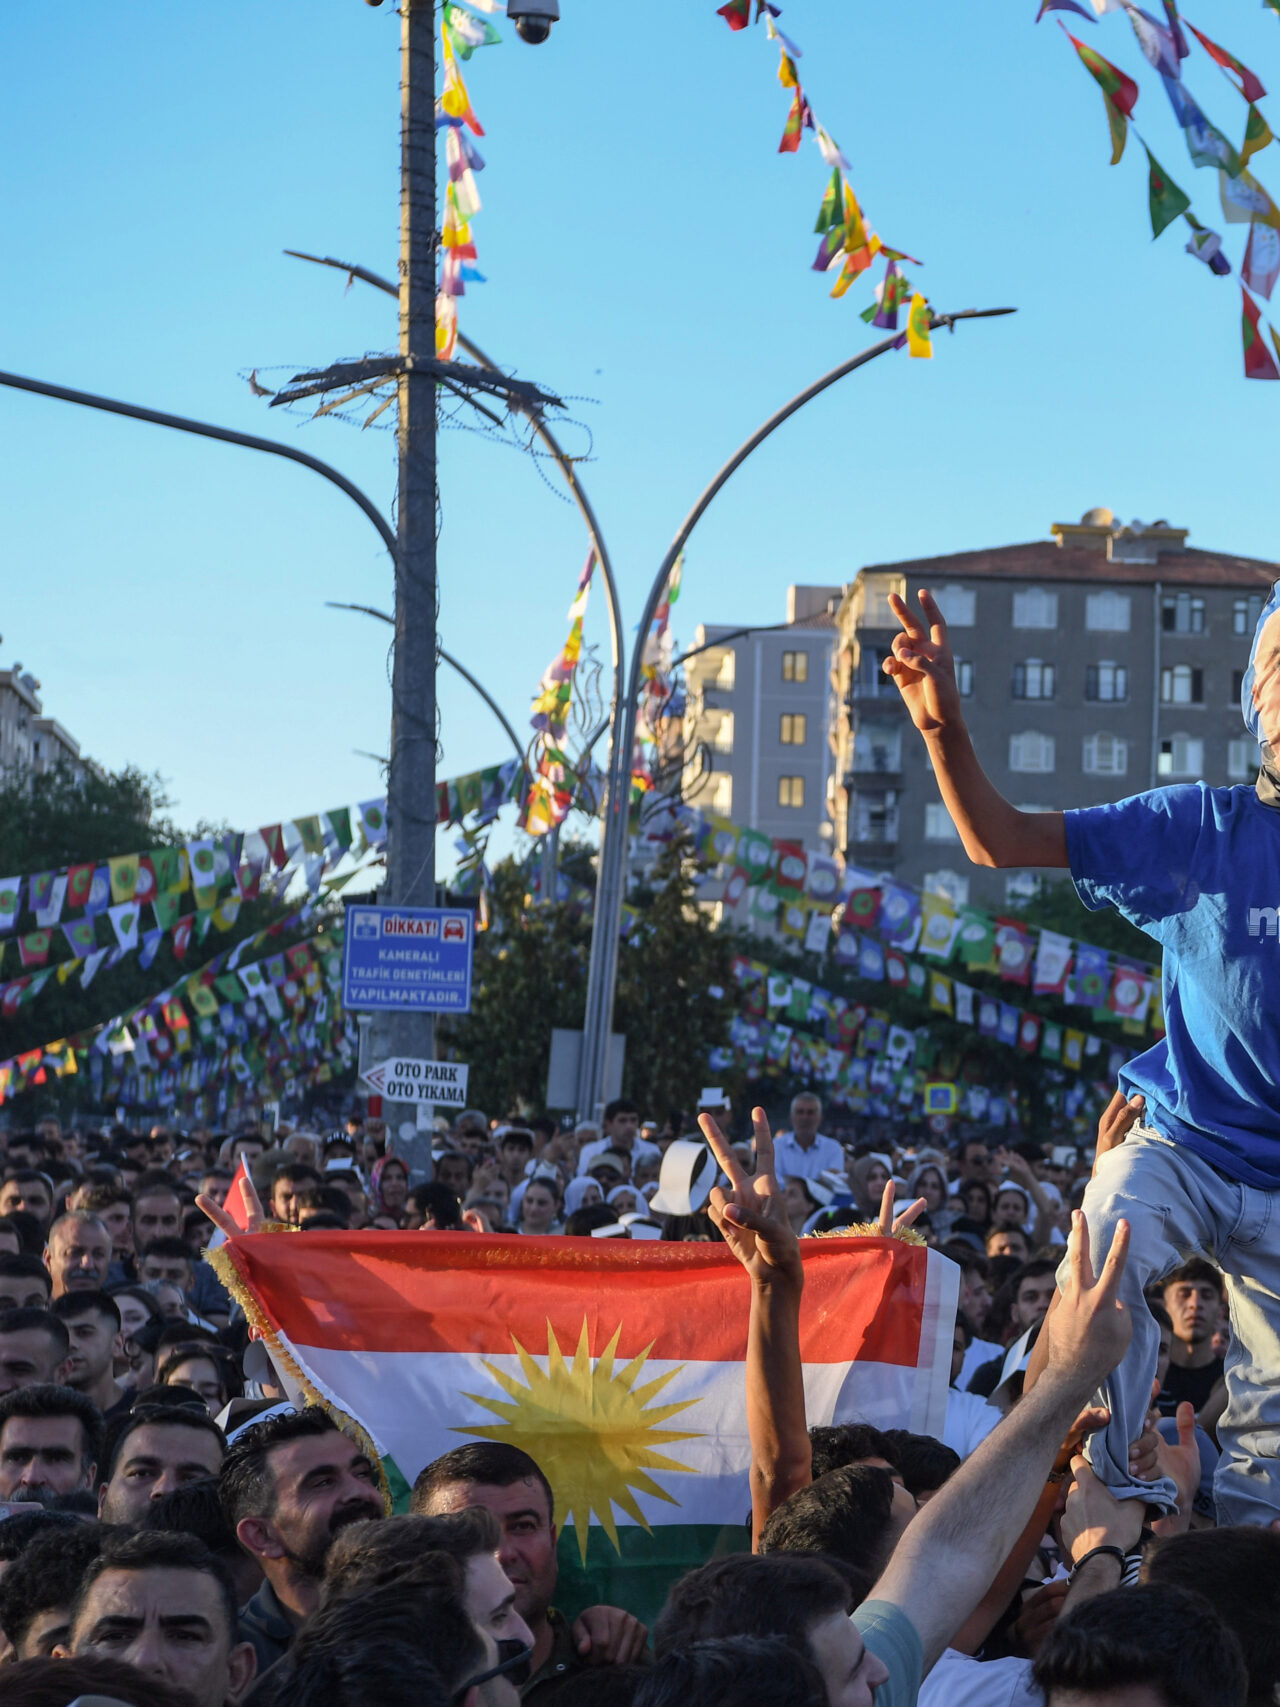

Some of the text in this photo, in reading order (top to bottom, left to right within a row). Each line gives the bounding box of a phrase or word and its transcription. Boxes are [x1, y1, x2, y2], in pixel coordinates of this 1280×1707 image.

[384, 915, 437, 934] DİKKAT!
[378, 949, 439, 963] KAMERALI
[352, 966, 465, 983] TRAFİK DENETİMLERİ
[350, 988, 462, 1004] YAPILMAKTADIR.
[395, 1062, 458, 1082] OTO PARK
[387, 1080, 465, 1102] OTO YIKAMA
